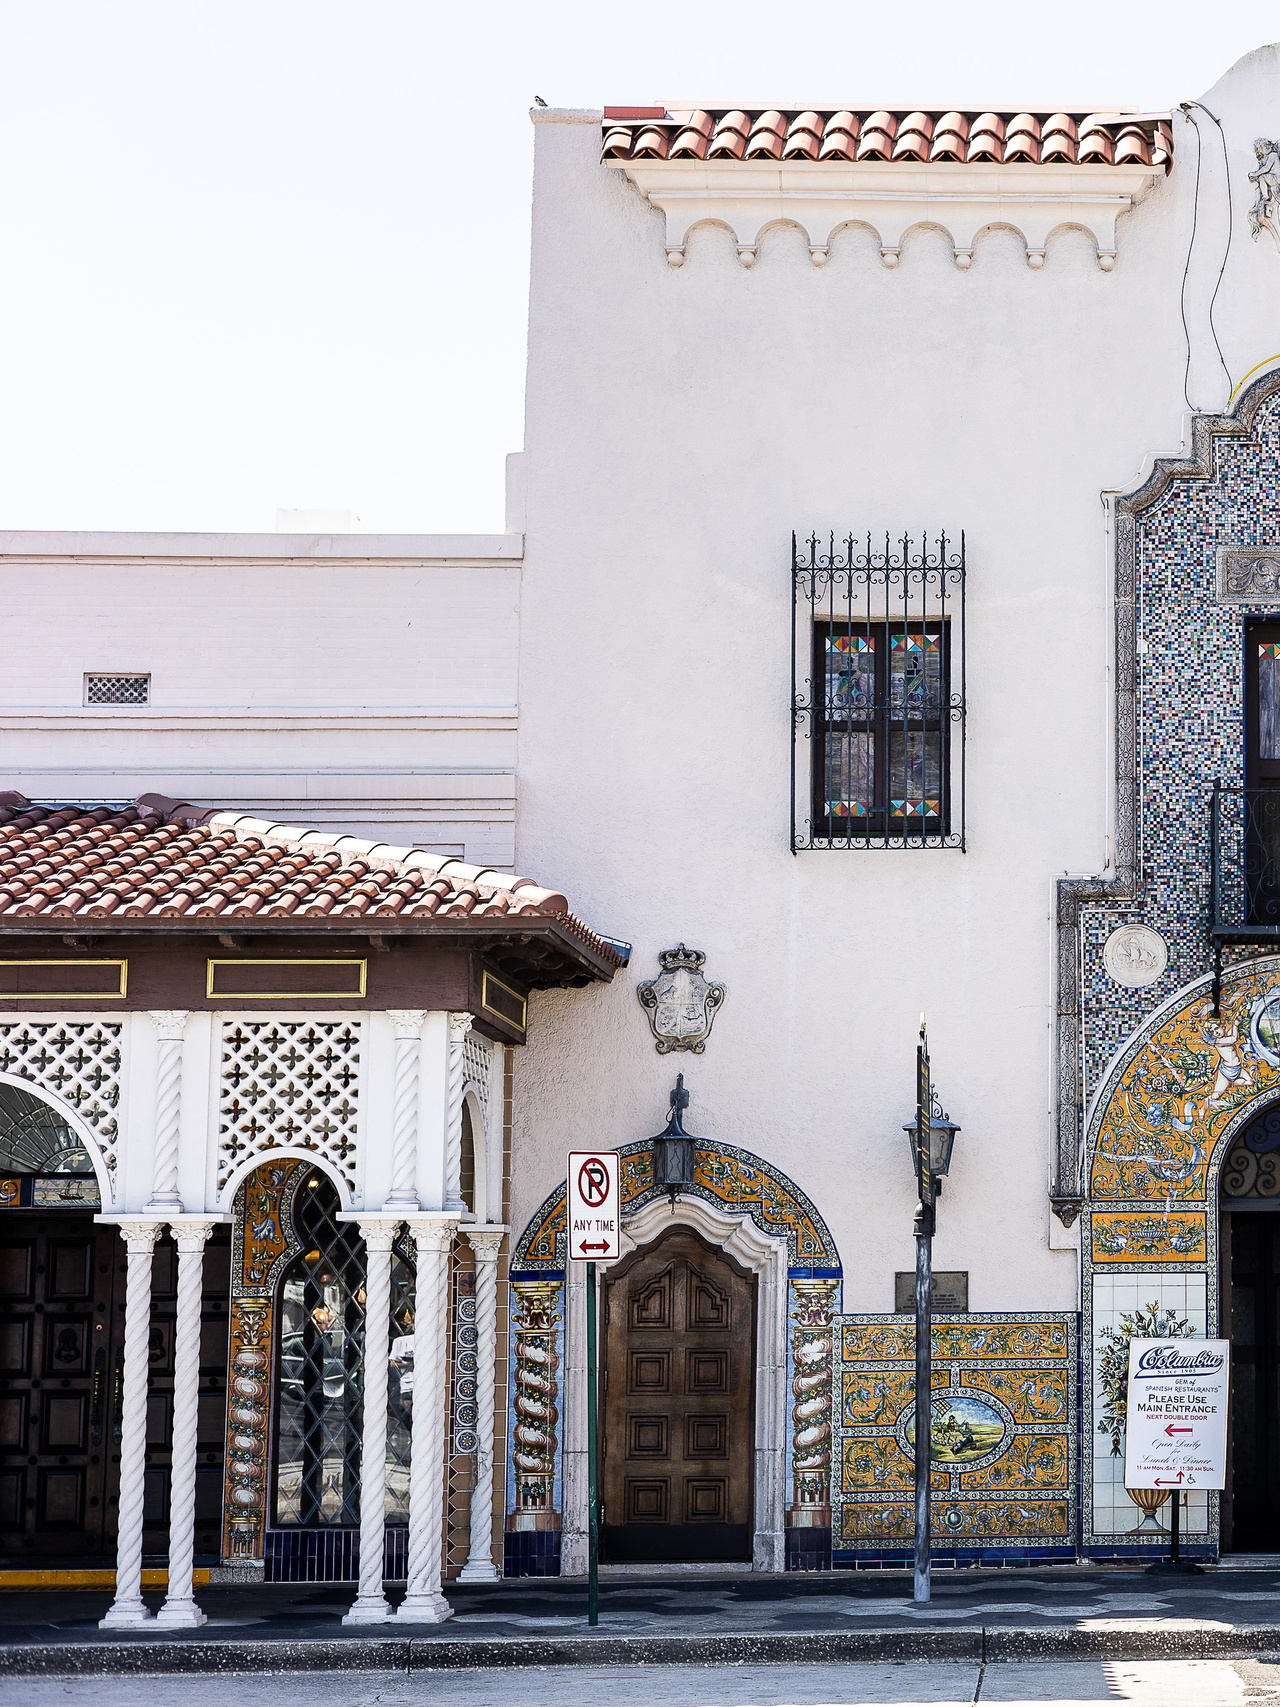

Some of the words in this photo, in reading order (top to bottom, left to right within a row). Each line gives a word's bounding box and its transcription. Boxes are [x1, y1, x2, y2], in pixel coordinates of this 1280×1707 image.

[573, 1220, 592, 1231] ANY
[595, 1220, 615, 1231] TIME
[1138, 1345, 1224, 1370] Columbia
[1165, 1404, 1217, 1413] ENTRANCE
[1152, 1438, 1173, 1450] Open
[1175, 1439, 1201, 1451] Daily
[1140, 1455, 1170, 1464] Lunch
[1182, 1455, 1212, 1465] Dinner
